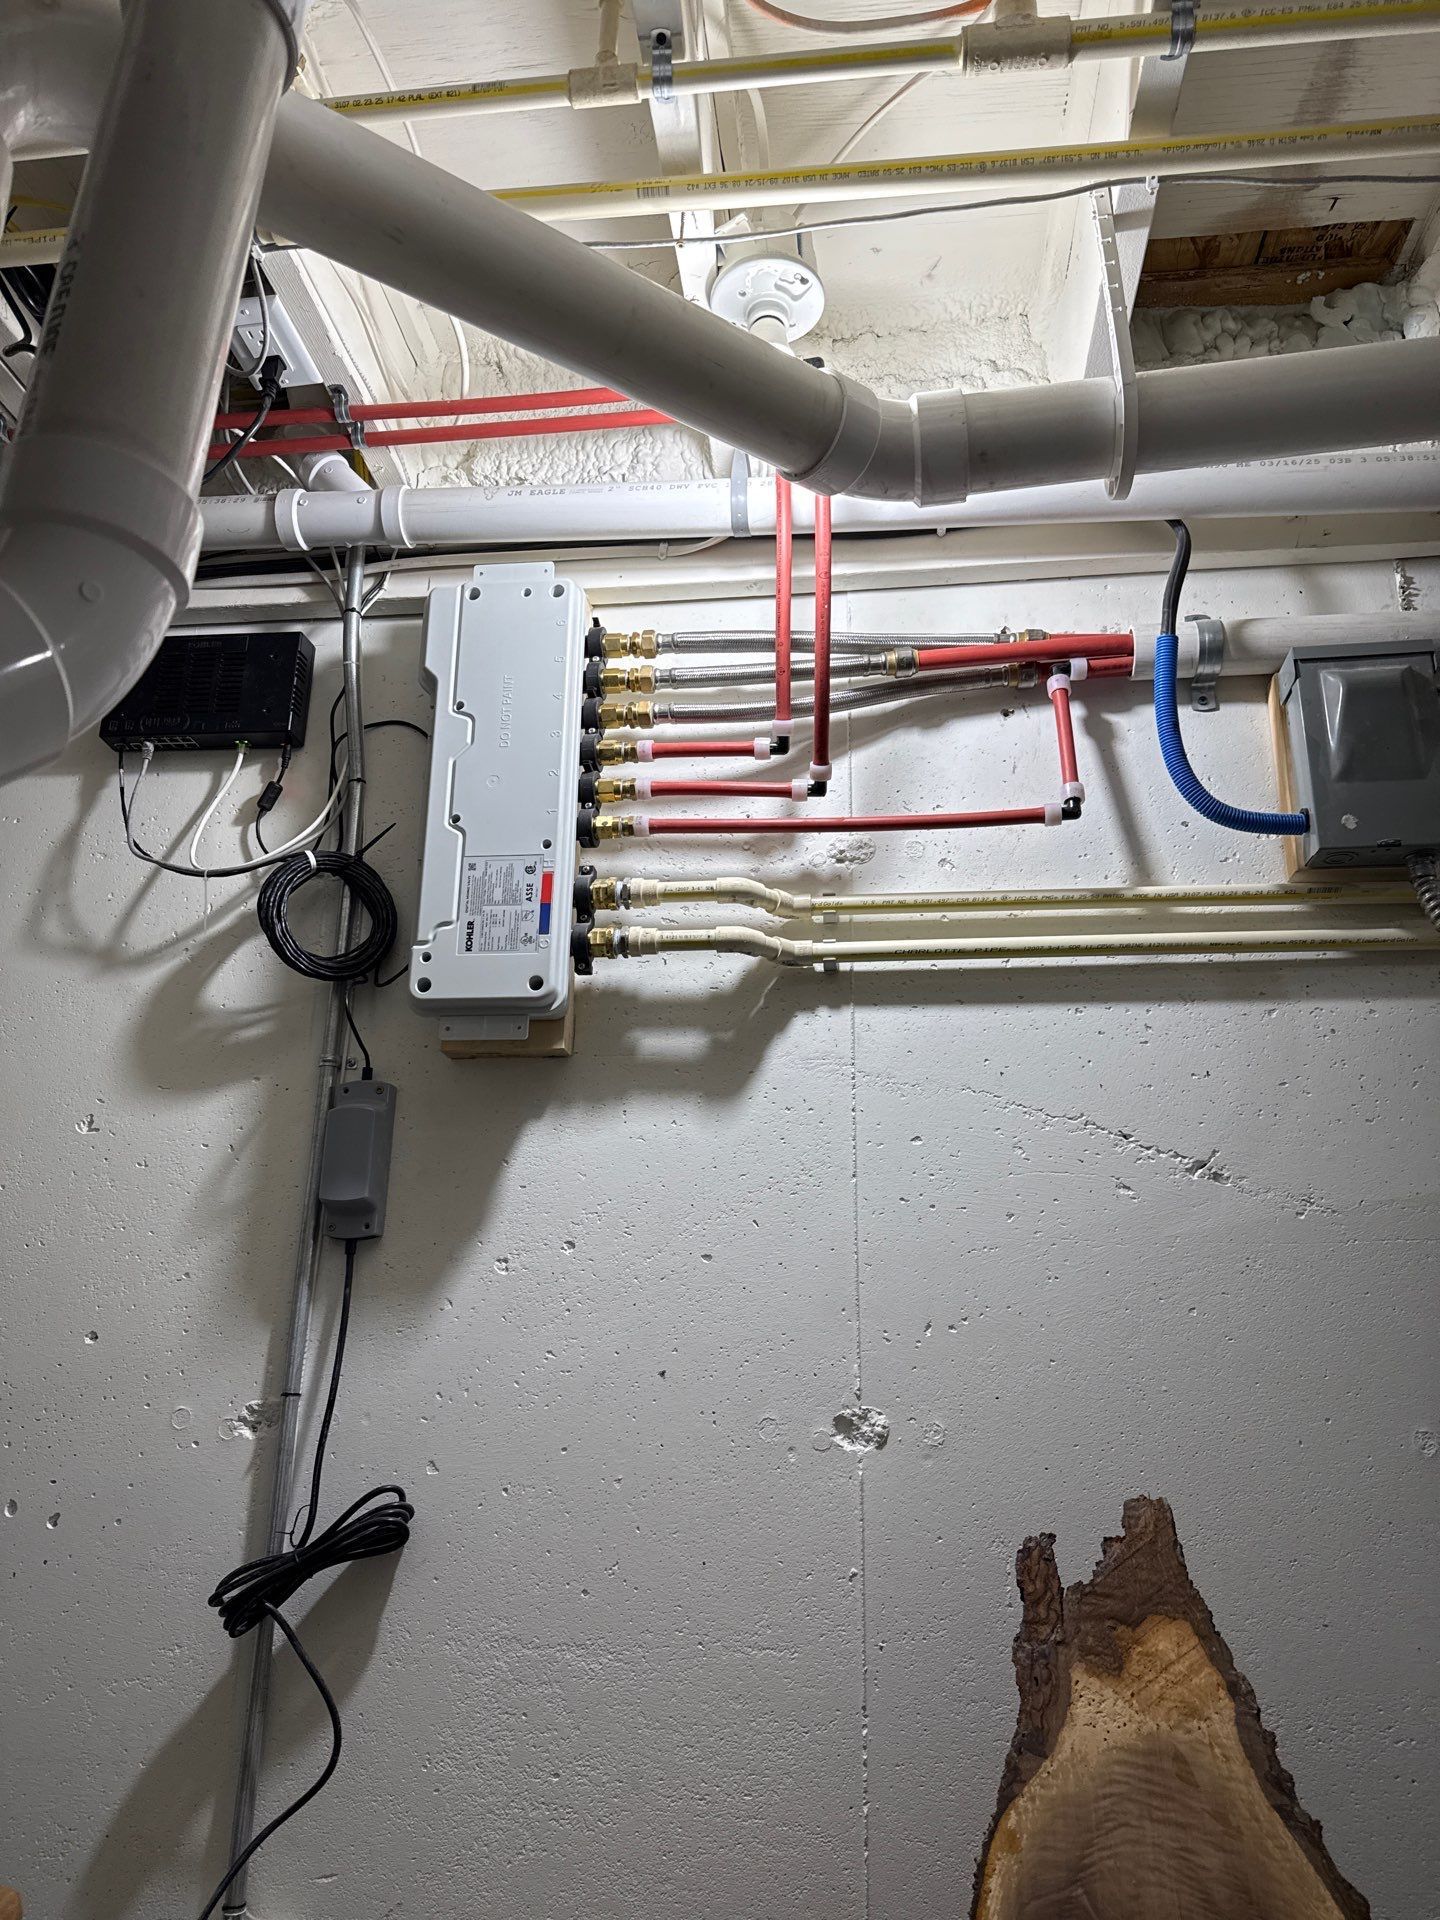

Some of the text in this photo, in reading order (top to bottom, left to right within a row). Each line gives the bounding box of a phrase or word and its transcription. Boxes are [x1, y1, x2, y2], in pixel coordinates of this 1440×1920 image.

[334, 100, 350, 109] 3107
[1259, 458, 1321, 468] 03/16/25
[507, 489, 522, 497] JM
[529, 488, 566, 496] EAGLE
[628, 484, 662, 492] SCH40
[498, 674, 515, 748] DO NOT PAINT
[525, 883, 534, 903] ASSE
[465, 920, 475, 952] KOHLER
[895, 947, 967, 955] CHARLOTTE
